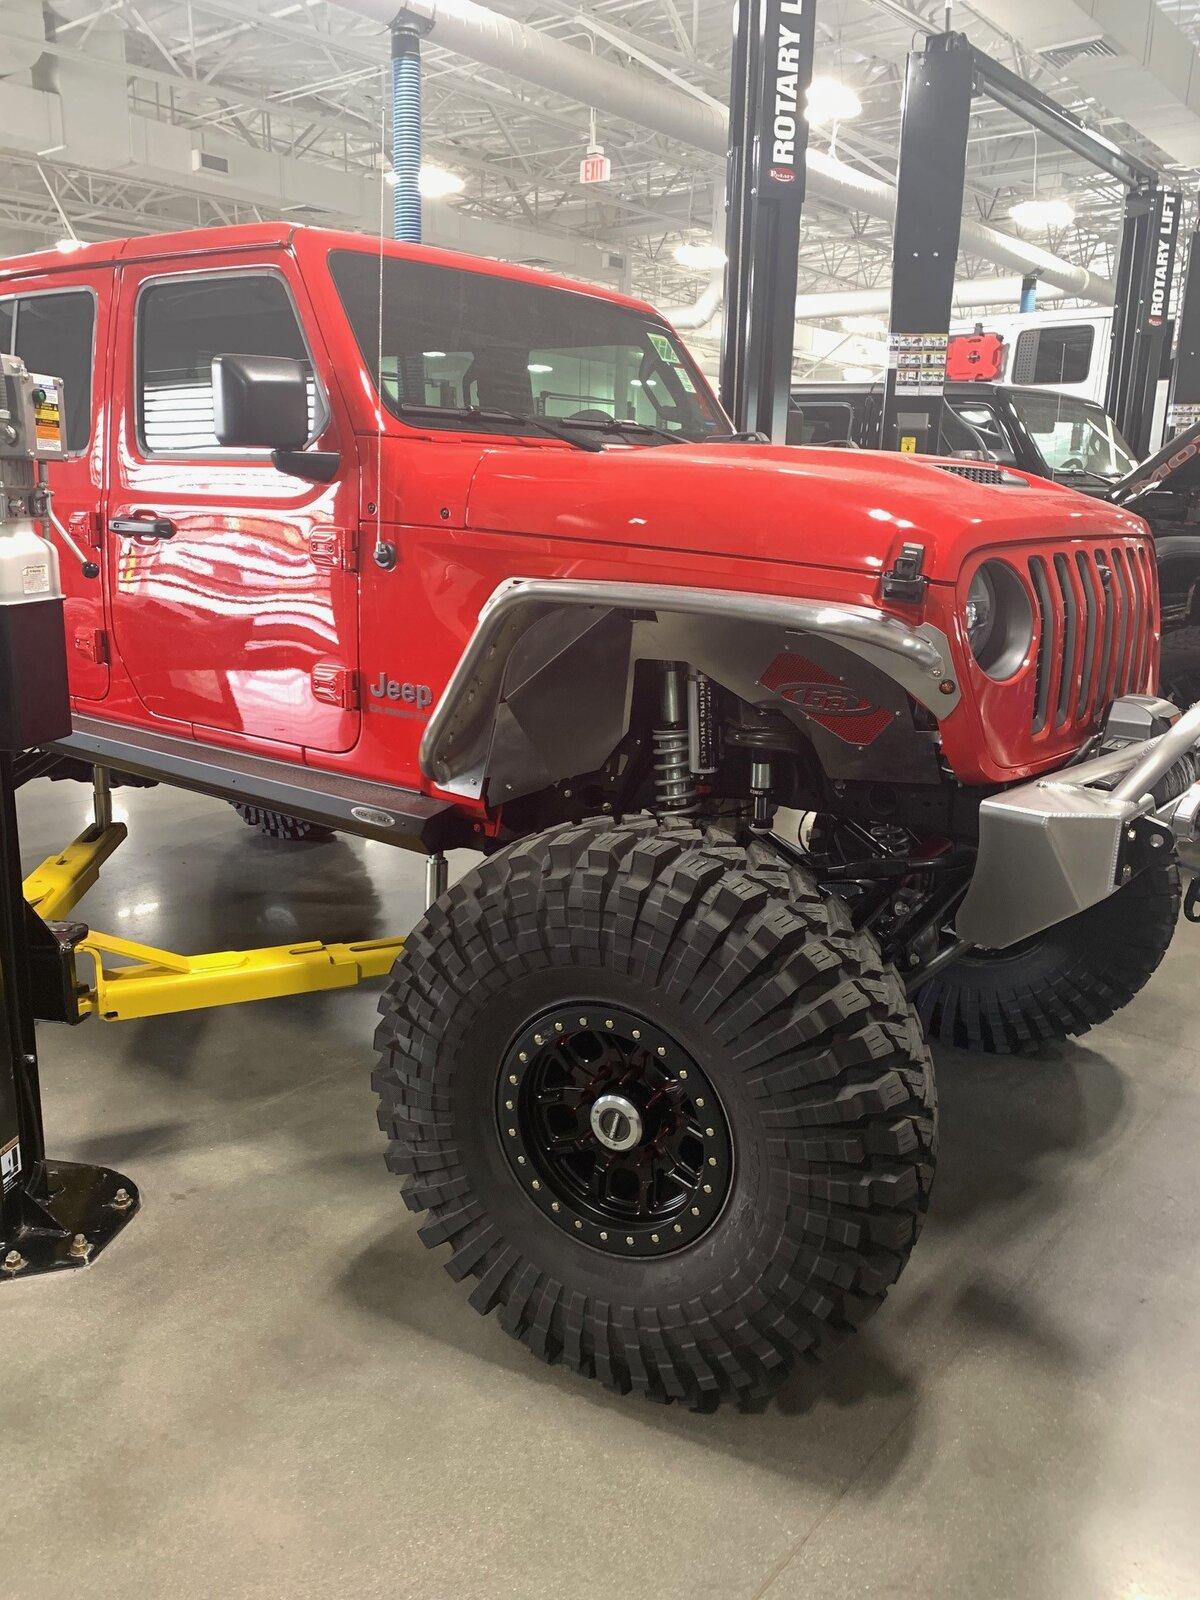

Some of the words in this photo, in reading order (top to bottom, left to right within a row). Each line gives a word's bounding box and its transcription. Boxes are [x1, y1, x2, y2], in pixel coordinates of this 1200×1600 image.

[773, 24, 800, 165] ROTARY
[584, 159, 605, 181] EXIT
[1150, 239, 1170, 316] ROTARY
[1160, 193, 1176, 235] LIFT
[369, 672, 432, 710] Jeep
